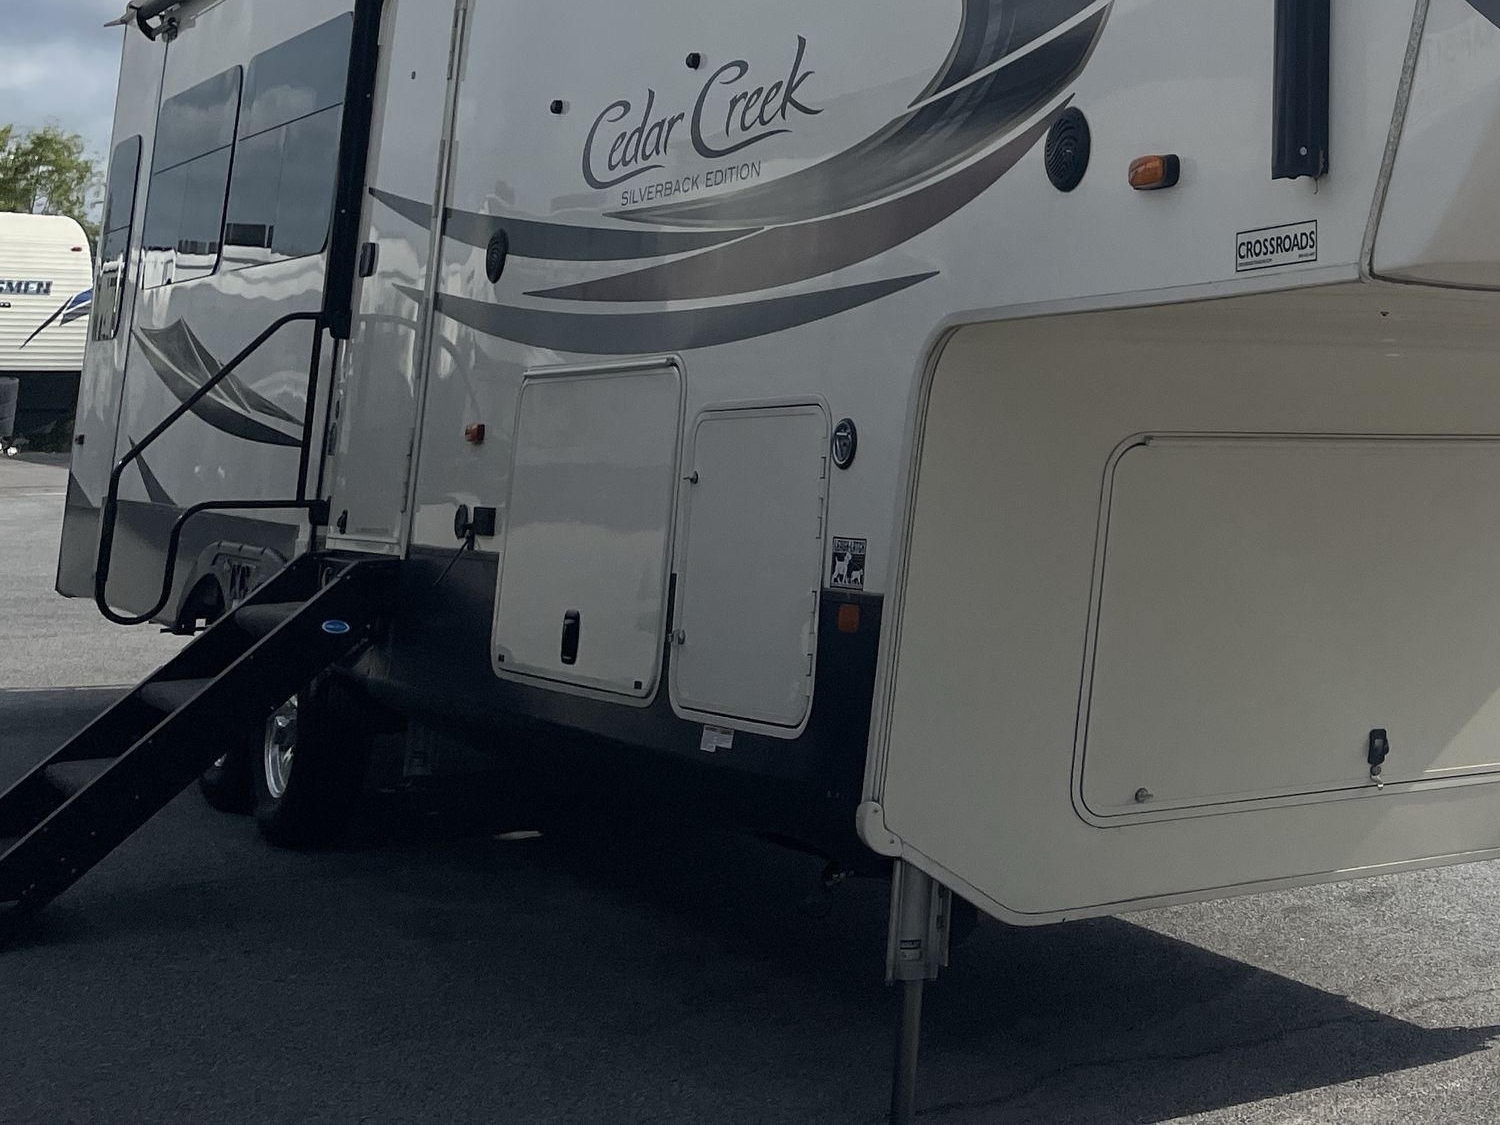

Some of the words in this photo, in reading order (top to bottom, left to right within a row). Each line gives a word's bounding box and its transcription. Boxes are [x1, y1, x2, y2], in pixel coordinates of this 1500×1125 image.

[582, 88, 685, 189] Cedar
[691, 35, 824, 158] Creek
[621, 177, 699, 206] SILVERBACK
[705, 161, 761, 188] EDITION
[1238, 230, 1315, 259] CROSSROADS
